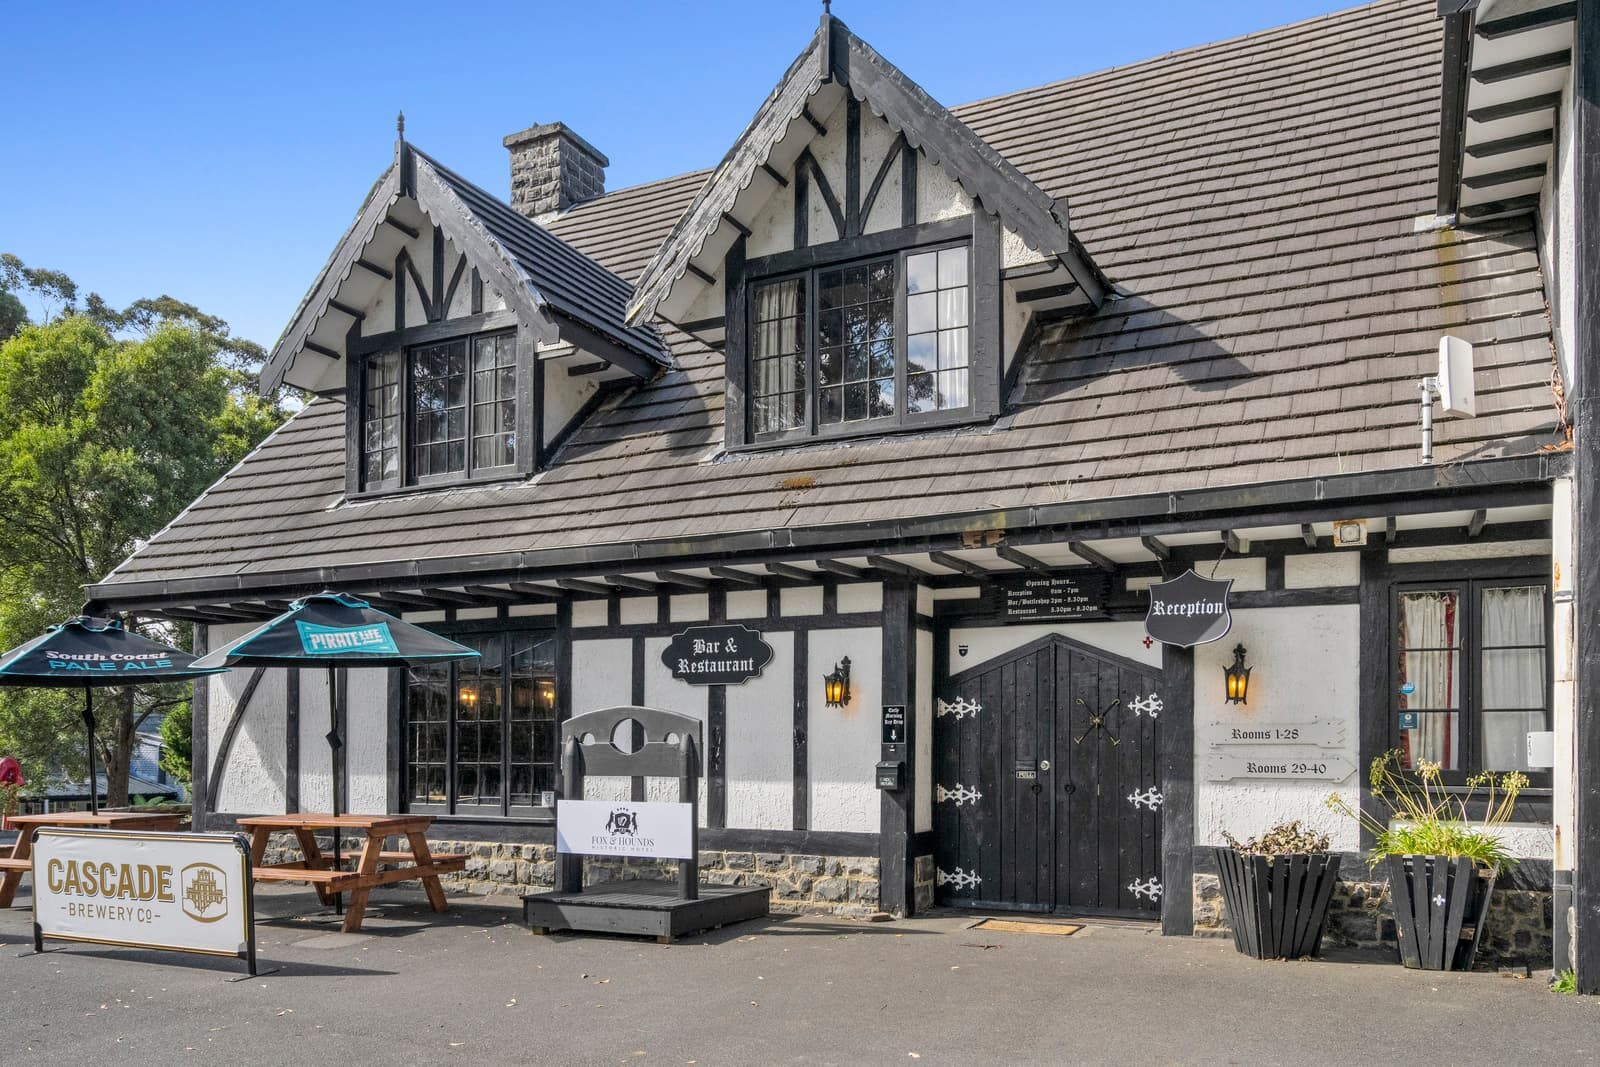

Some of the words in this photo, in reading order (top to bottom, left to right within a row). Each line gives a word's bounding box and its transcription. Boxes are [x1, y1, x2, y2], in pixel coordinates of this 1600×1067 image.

[1152, 598, 1223, 617] Reception
[692, 639, 720, 656] Bar
[724, 637, 738, 653] &
[46, 650, 108, 661] South
[110, 651, 170, 661] Coast
[48, 660, 117, 671] PALE
[123, 659, 174, 671] ALE
[677, 657, 754, 673] Restaurant
[1231, 728, 1271, 740] Rooms
[1276, 729, 1300, 740] 1-28
[1246, 762, 1287, 774] Rooms
[1291, 763, 1327, 774] 29-40
[592, 835, 608, 845] FOX
[609, 836, 617, 845] &
[618, 837, 655, 847] HOUNDS
[47, 858, 175, 903] CASCADE
